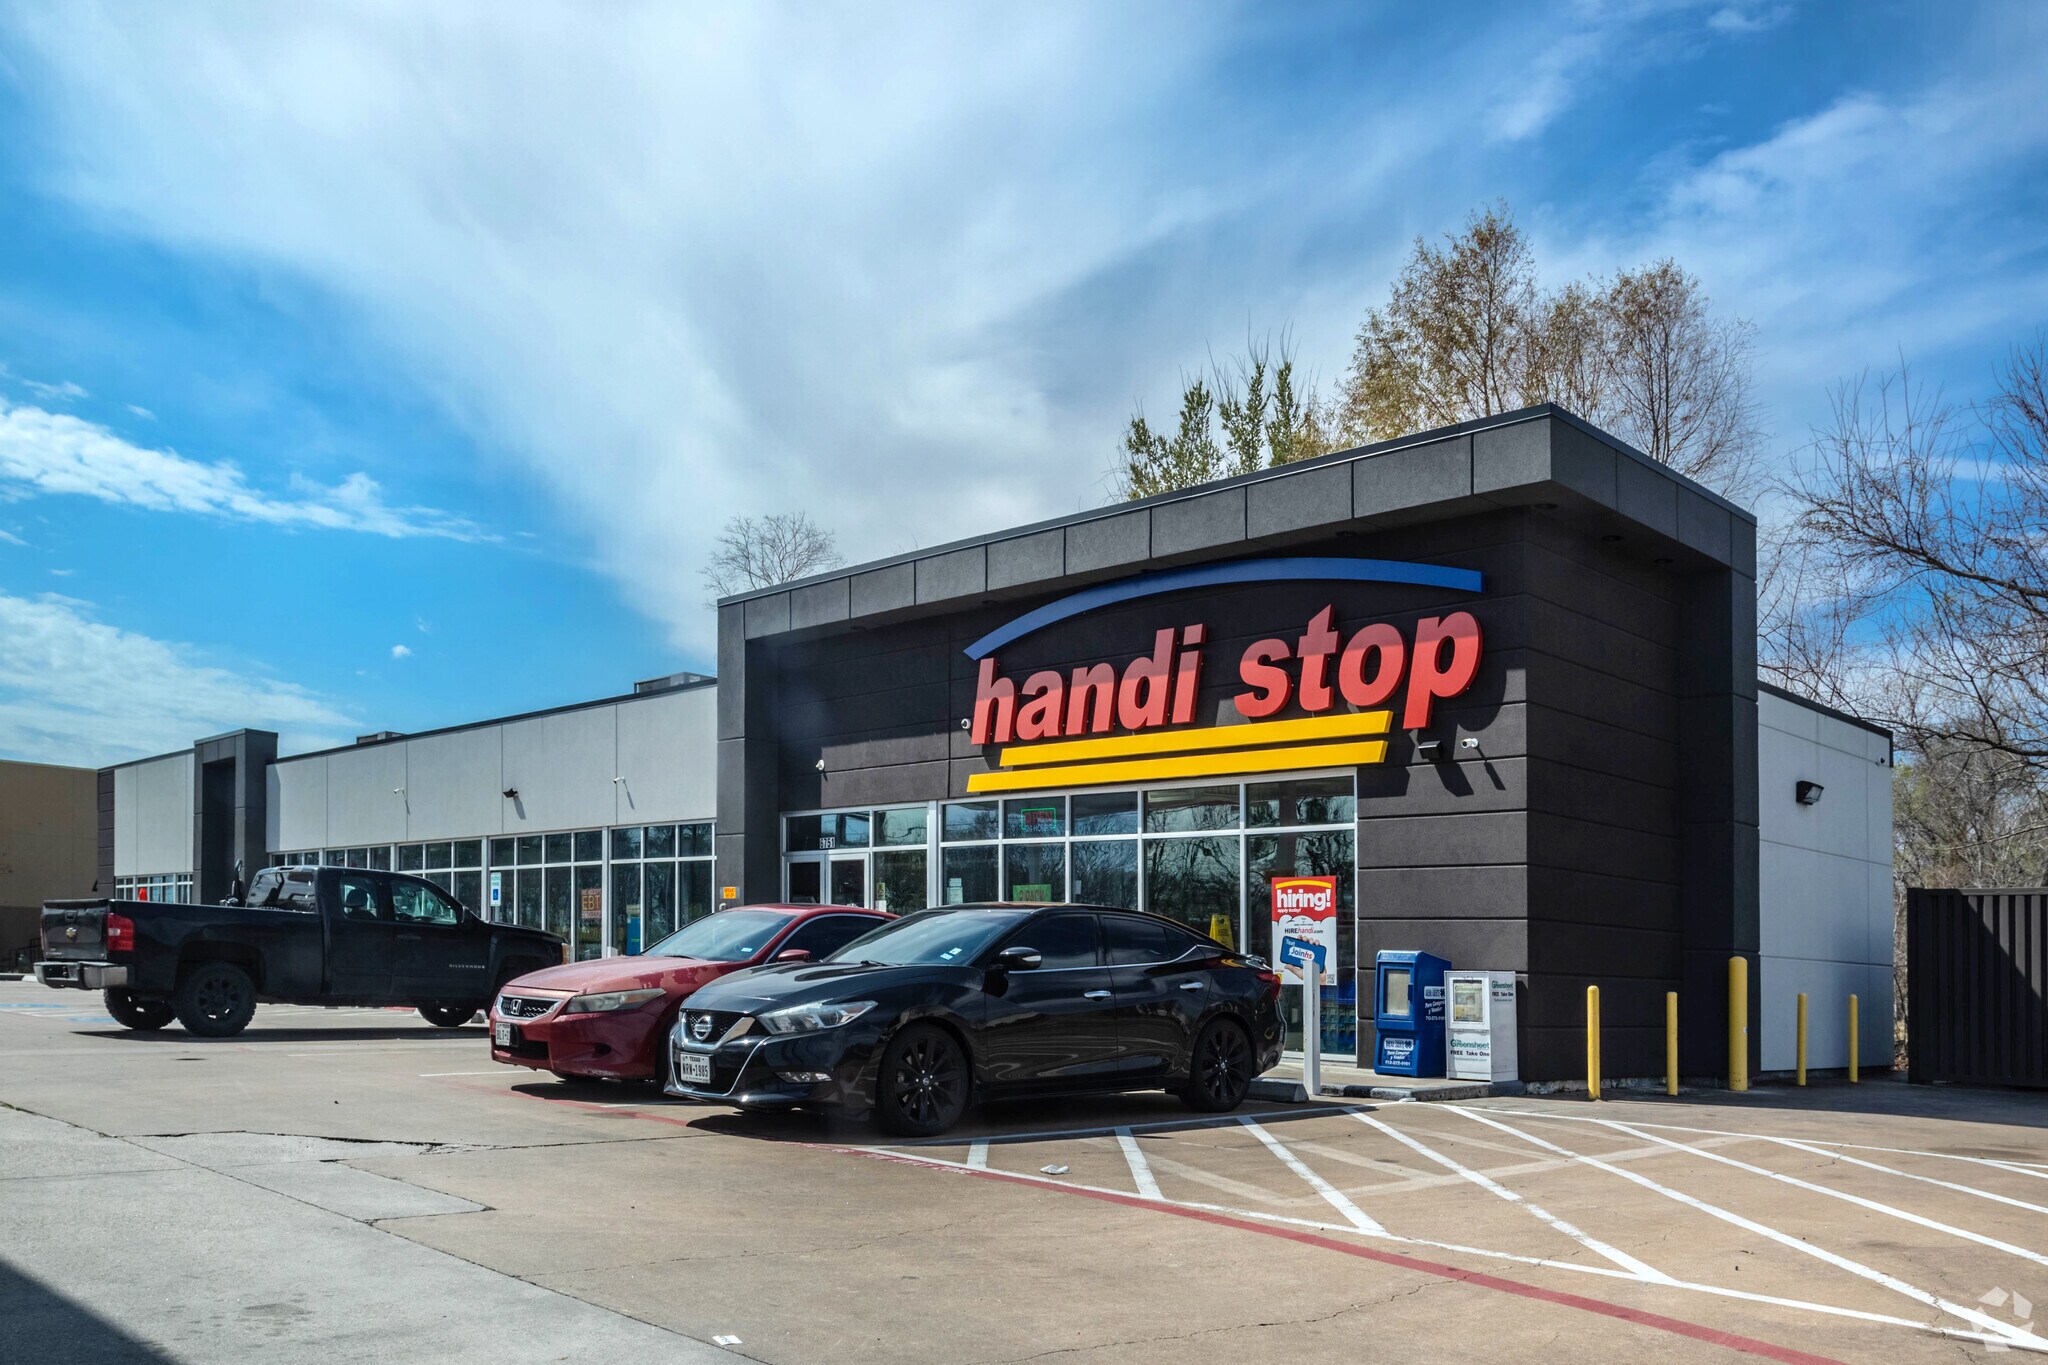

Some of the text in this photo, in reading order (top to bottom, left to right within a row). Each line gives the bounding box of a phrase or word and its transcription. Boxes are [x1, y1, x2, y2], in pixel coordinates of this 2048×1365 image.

[970, 604, 1484, 746] handi stop
[1024, 811, 1054, 825] OPEN
[582, 896, 600, 910] EBT
[1277, 889, 1331, 911] hiring!
[1450, 1039, 1490, 1049] Greensheet
